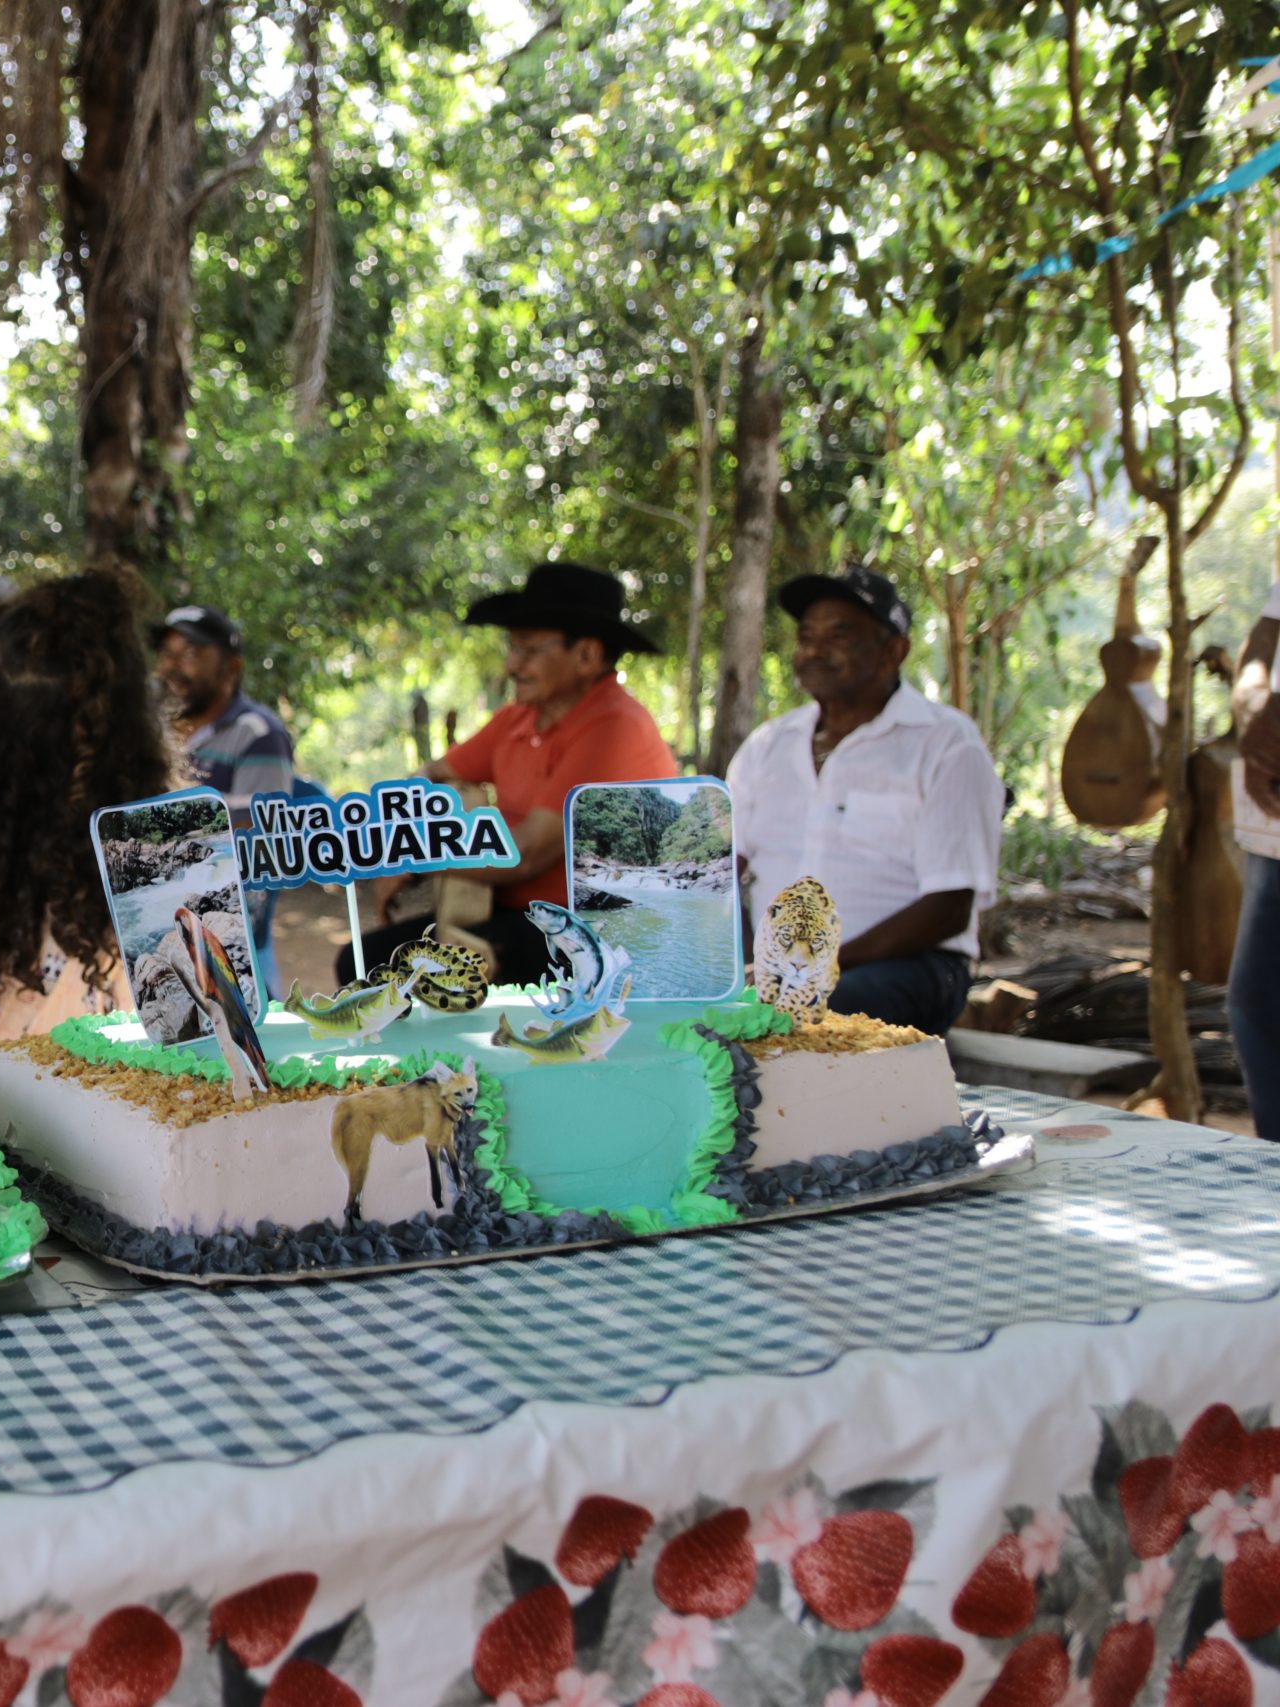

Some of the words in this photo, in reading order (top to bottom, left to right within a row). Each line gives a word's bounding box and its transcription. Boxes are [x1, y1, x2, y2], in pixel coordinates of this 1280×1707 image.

[256, 803, 330, 834] Viva
[343, 803, 367, 825] o
[381, 789, 450, 821] Rio
[237, 819, 508, 881] JAUQUARA
